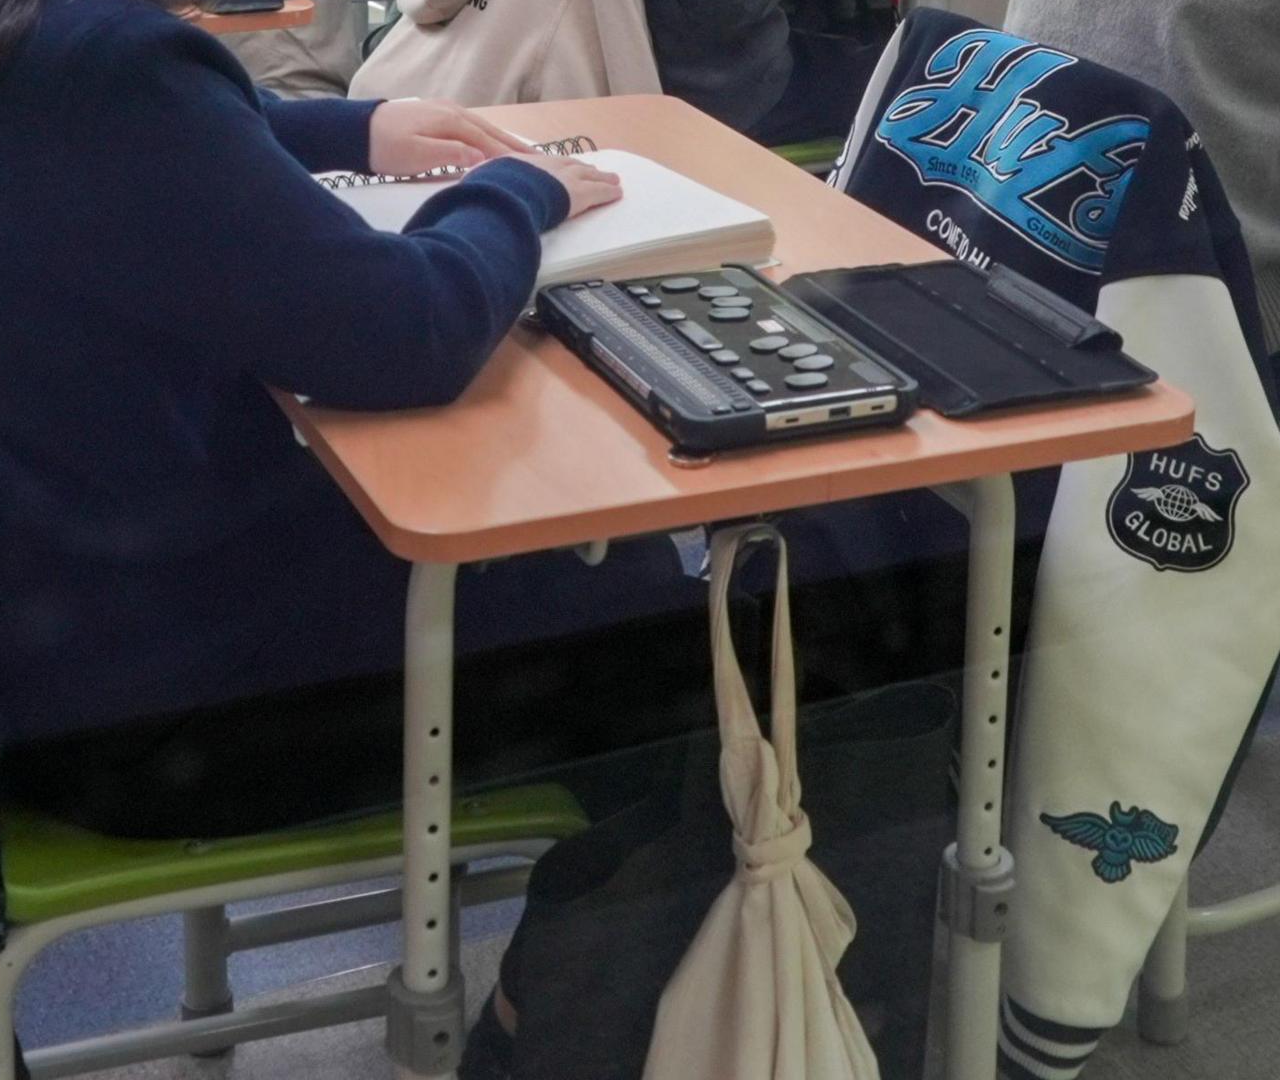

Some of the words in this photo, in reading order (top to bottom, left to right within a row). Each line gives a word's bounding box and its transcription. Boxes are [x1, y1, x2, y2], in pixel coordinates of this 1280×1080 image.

[927, 156, 958, 176] Since
[1026, 217, 1072, 254] Global
[1149, 452, 1223, 491] HUFS
[1124, 510, 1213, 554] GLOBAL
